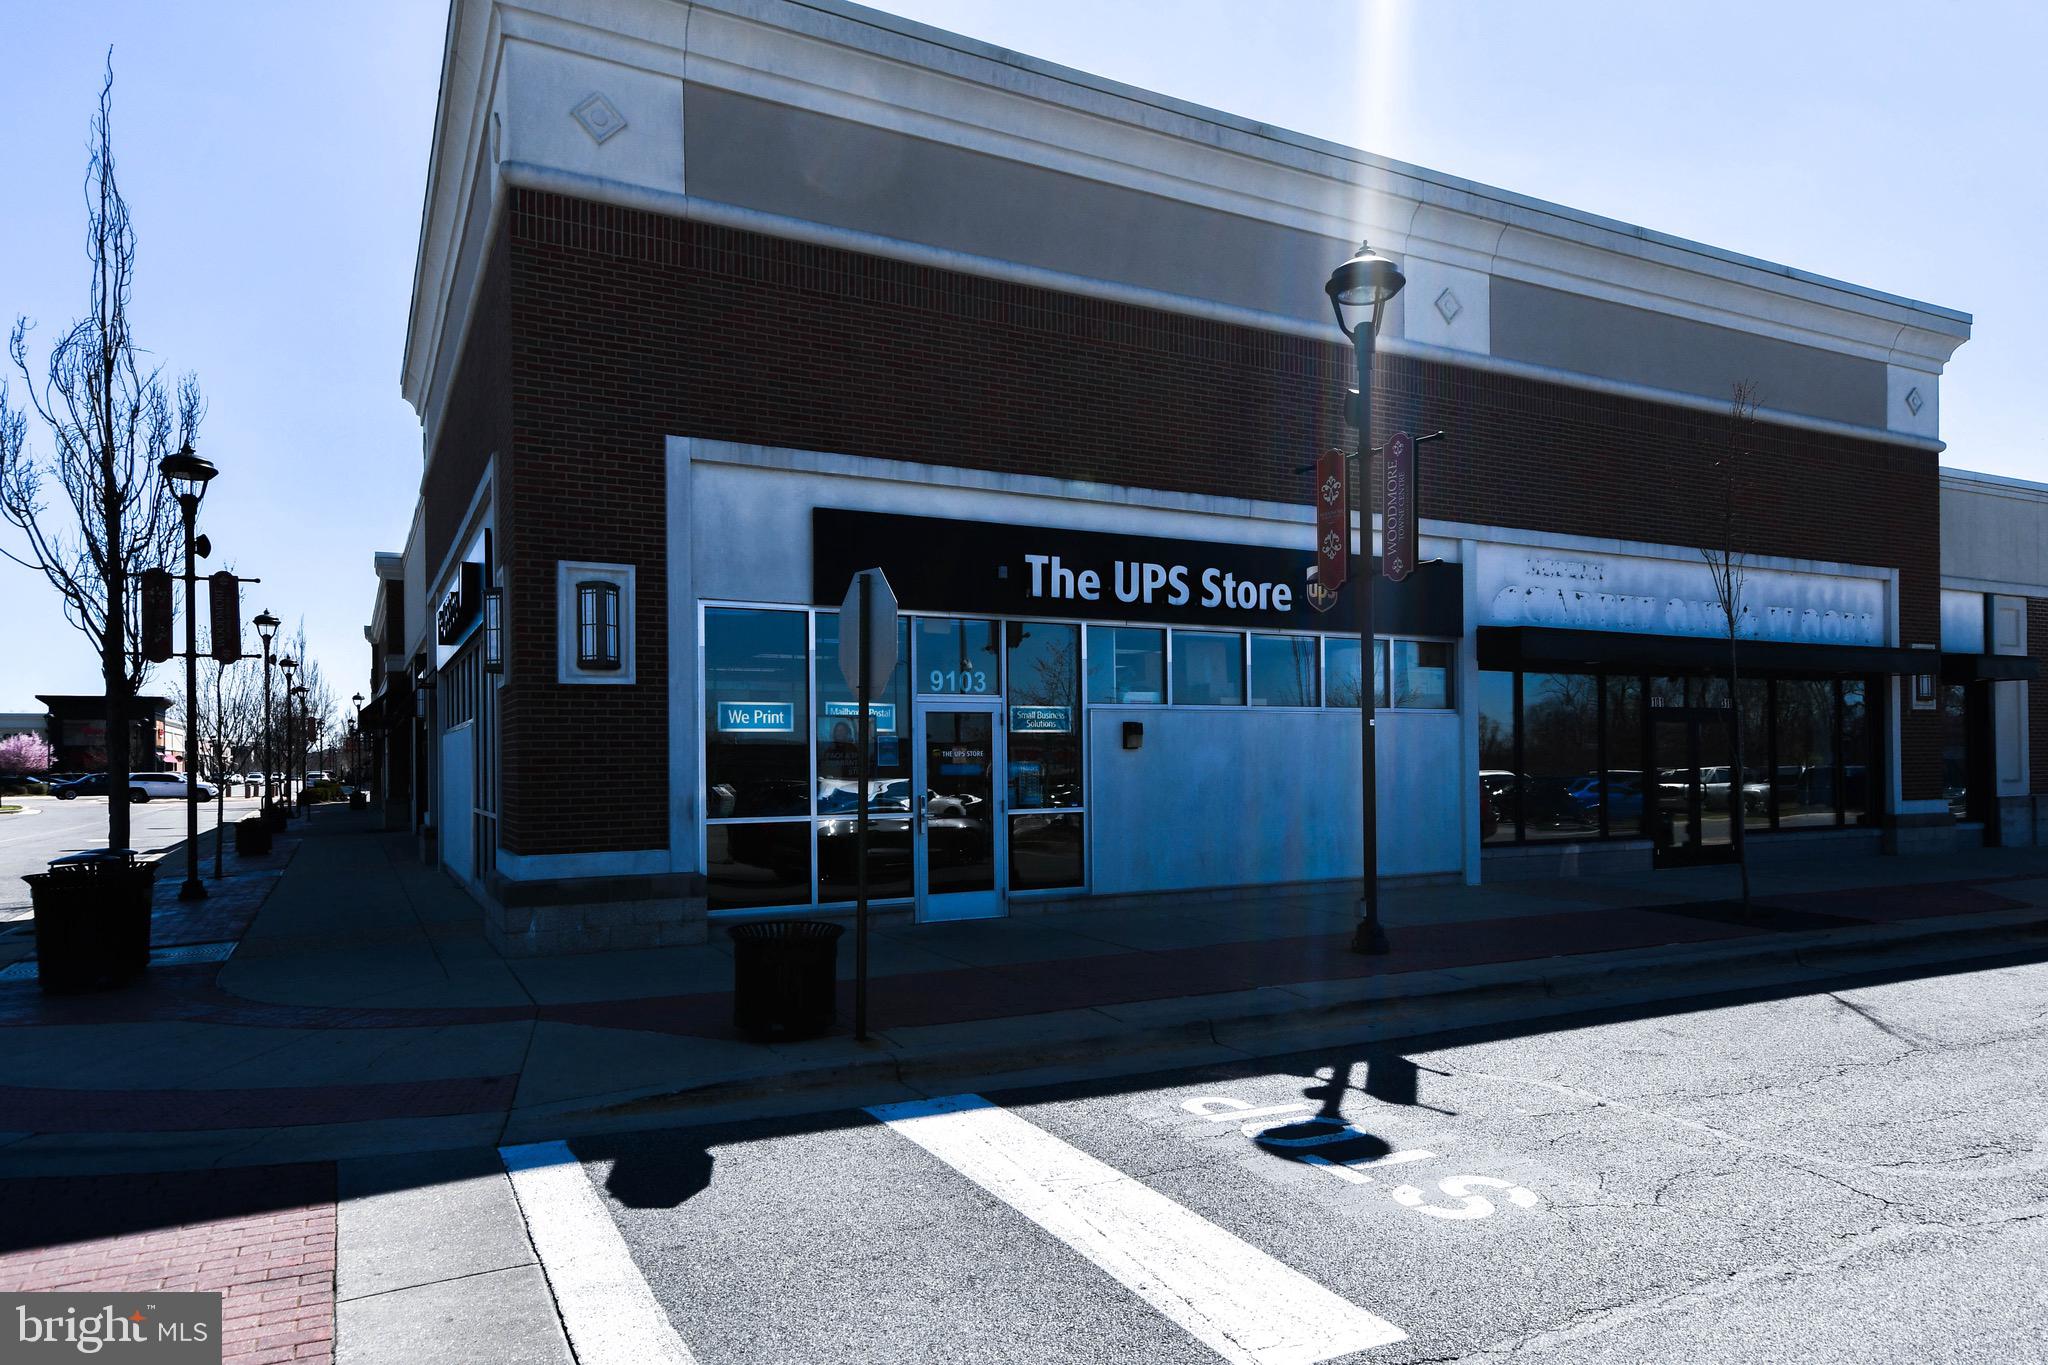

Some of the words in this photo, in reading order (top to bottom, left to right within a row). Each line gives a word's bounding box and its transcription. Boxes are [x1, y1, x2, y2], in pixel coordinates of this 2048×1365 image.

[1398, 471, 1406, 509] CENTRE
[1386, 458, 1399, 557] WOODMORE
[1398, 510, 1406, 541] TOWNE
[1024, 553, 1100, 601] The
[1114, 560, 1190, 606] UPS
[1201, 567, 1293, 612] Store
[930, 669, 987, 693] 9103
[728, 709, 750, 724] We
[754, 709, 785, 724] Print
[1017, 710, 1036, 719] Small
[1037, 711, 1065, 720] Business
[1026, 719, 1056, 728] Solutions
[942, 750, 953, 758] THE
[953, 750, 965, 758] UPS
[966, 750, 984, 758] STORE
